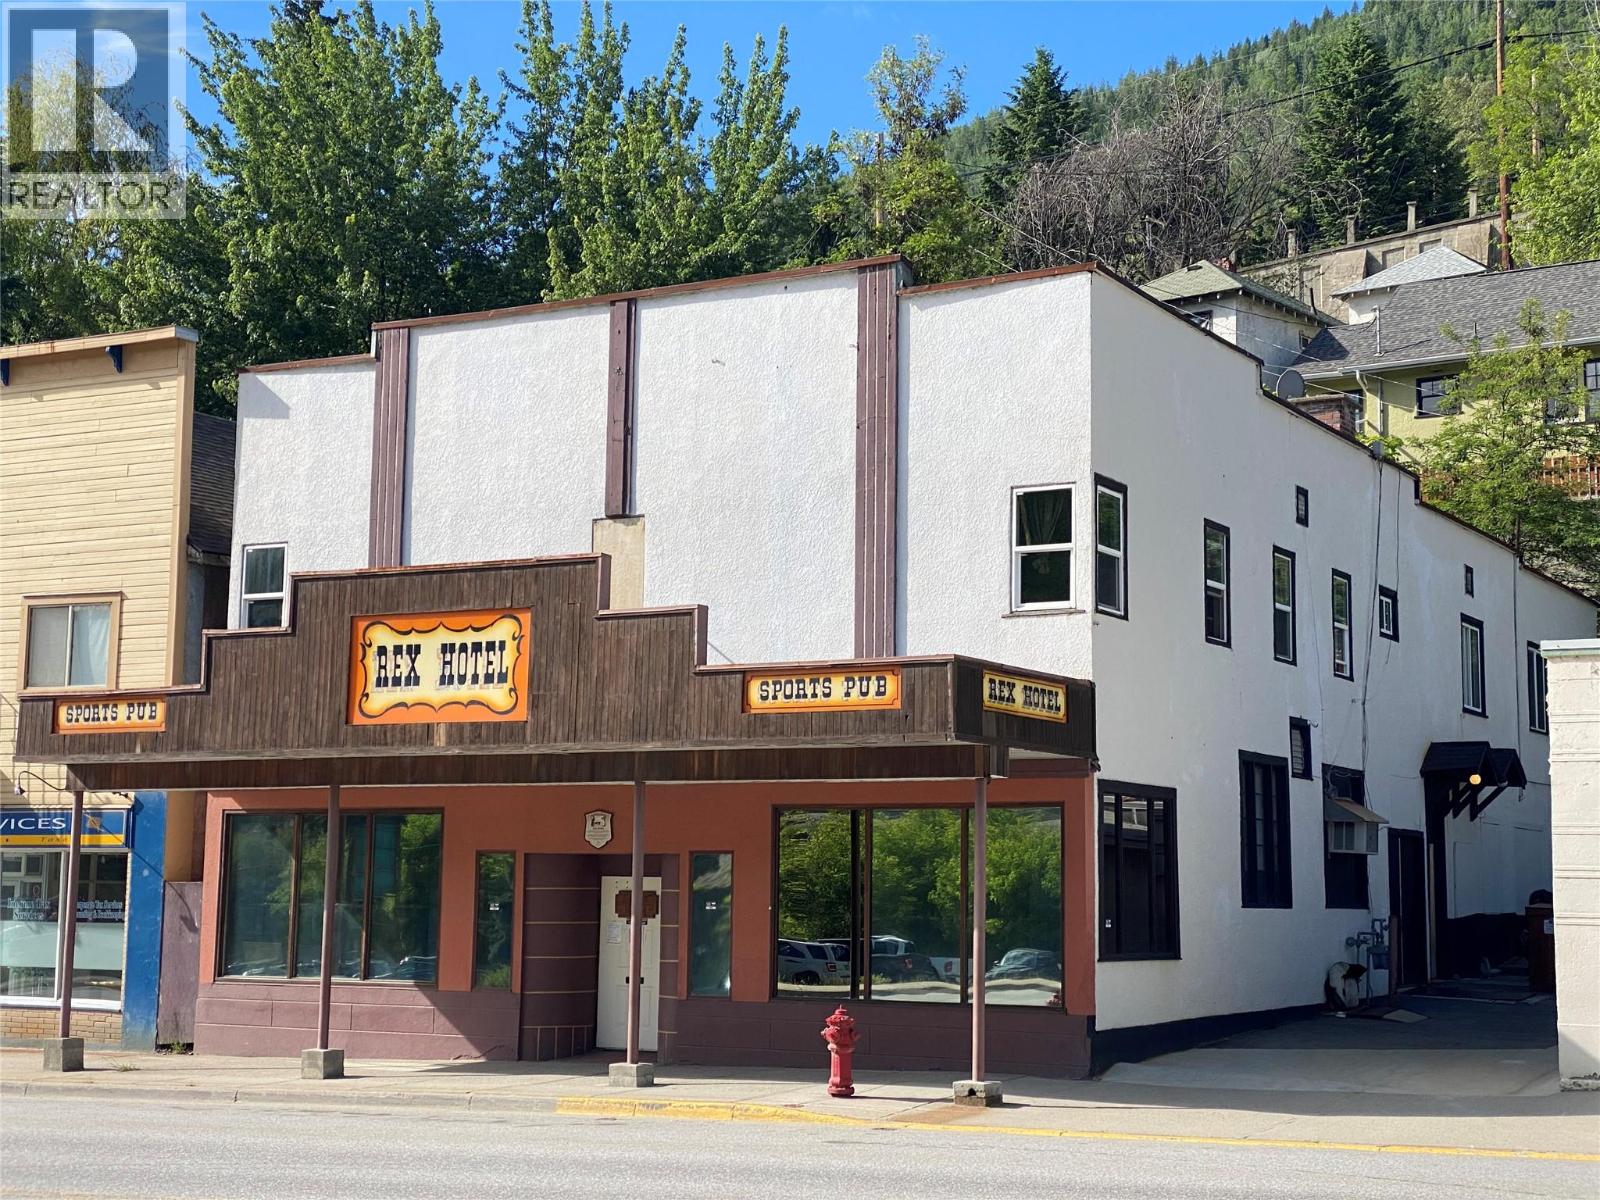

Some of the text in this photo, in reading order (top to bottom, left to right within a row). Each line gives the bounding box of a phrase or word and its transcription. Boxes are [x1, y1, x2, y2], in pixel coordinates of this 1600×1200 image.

[375, 640, 508, 688] REX HOTEL
[760, 675, 887, 701] SPORTS PUB
[988, 678, 1061, 712] REX HOTEL
[66, 702, 157, 723] SPORTS PUB
